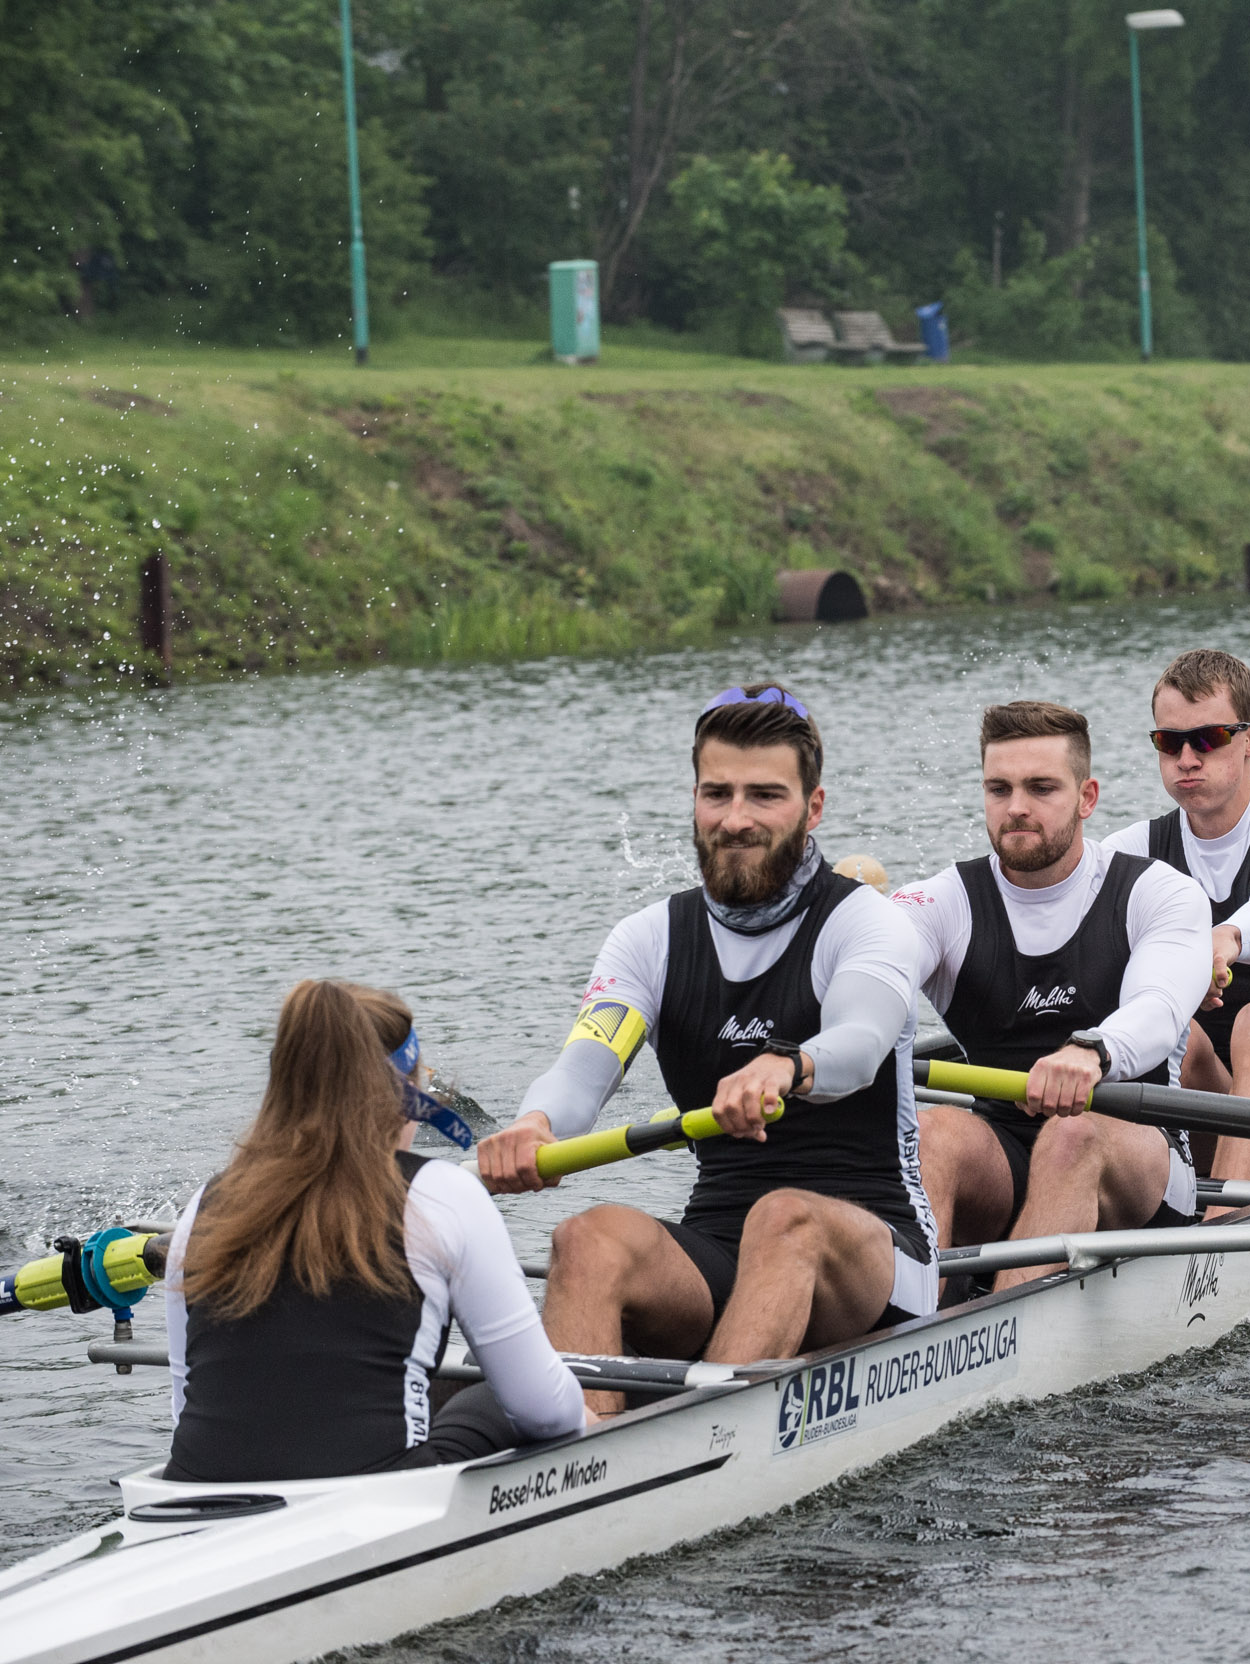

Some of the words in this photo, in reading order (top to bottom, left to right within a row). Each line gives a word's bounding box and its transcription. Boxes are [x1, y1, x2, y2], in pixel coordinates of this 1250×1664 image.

[806, 1356, 860, 1424] RBL
[865, 1316, 1017, 1406] RUDER-BUNDESLIGA
[803, 1413, 857, 1441] RUDER-BUNDESLIGA
[489, 1471, 557, 1515] Bessel-R.C.
[561, 1456, 607, 1493] Minden
